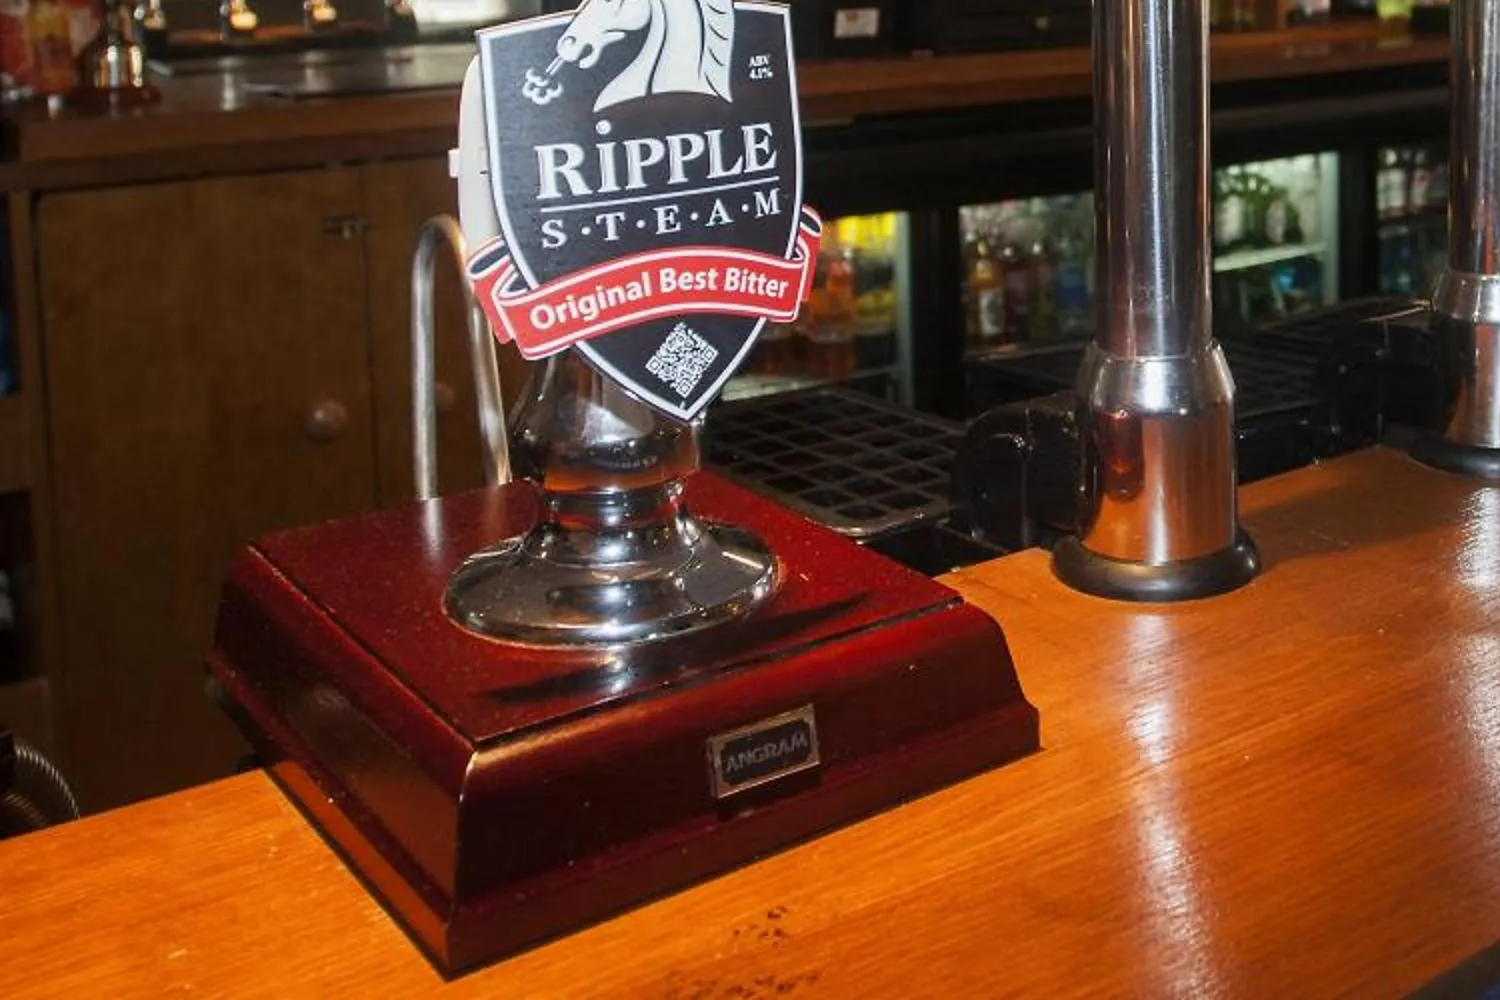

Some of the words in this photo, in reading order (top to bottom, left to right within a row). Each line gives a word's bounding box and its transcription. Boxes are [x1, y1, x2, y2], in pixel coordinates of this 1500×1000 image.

[530, 275, 652, 331] Original
[660, 267, 718, 292] Best
[723, 265, 790, 300] Bitter
[726, 729, 808, 773] ANGRAM
